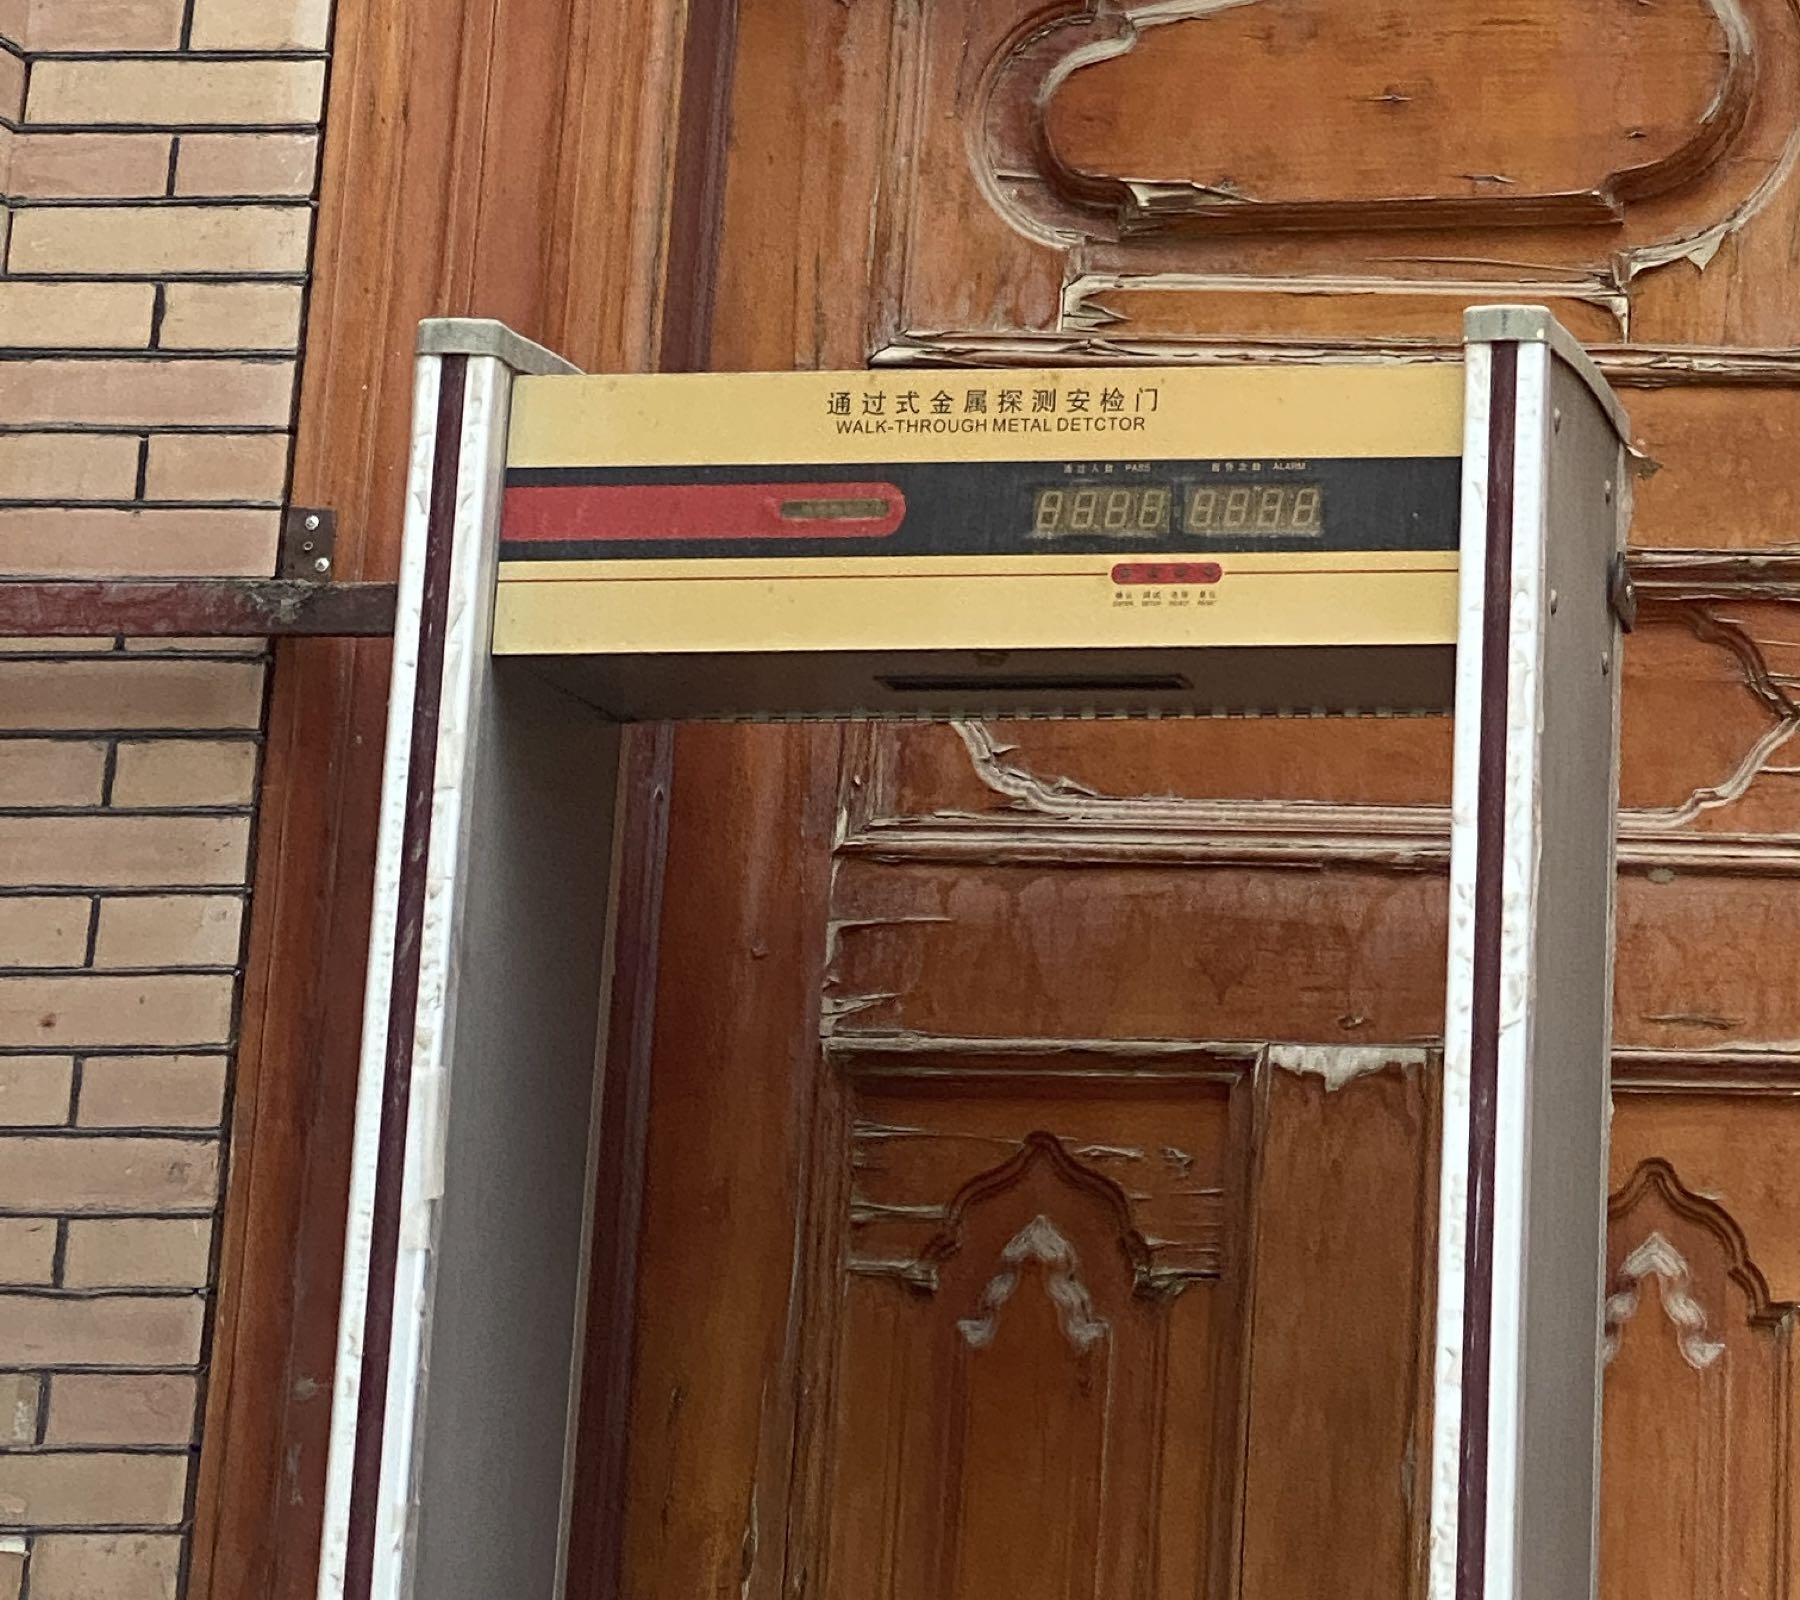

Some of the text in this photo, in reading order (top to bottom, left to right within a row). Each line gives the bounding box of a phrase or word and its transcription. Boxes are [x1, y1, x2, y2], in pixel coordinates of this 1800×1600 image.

[826, 386, 1162, 416] 通过式金属探测安检门
[835, 416, 1147, 435] WALK-THROUGH METAL DETCTOR
